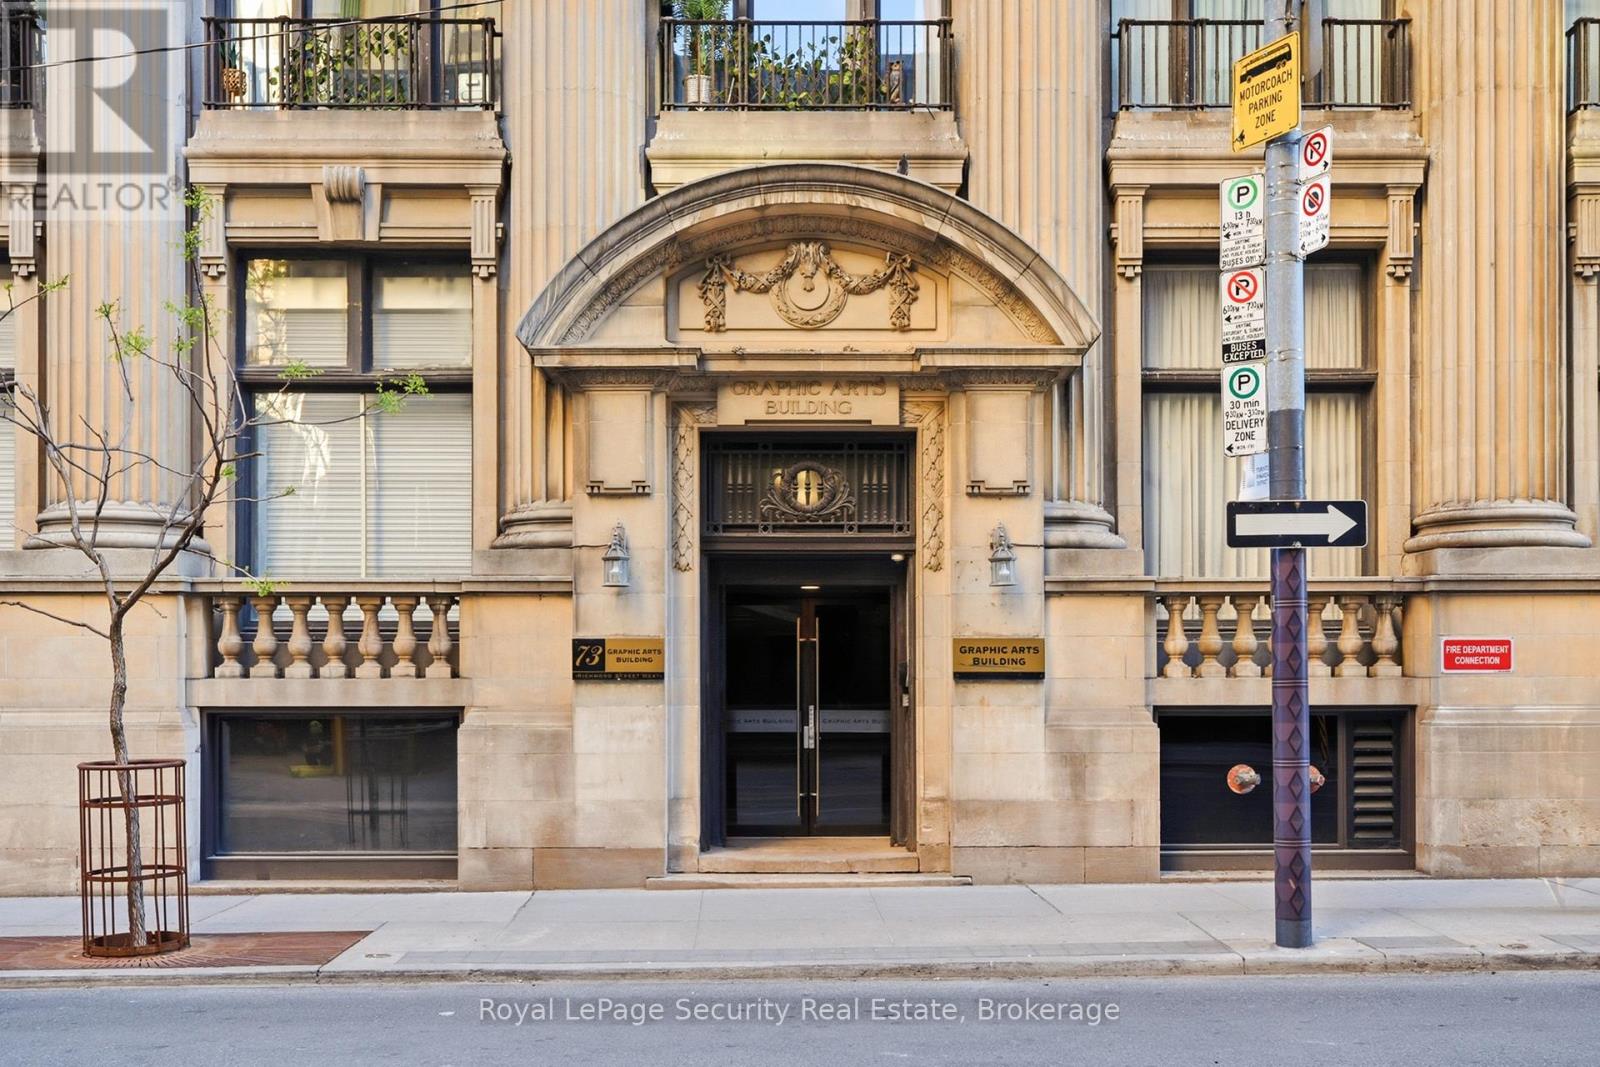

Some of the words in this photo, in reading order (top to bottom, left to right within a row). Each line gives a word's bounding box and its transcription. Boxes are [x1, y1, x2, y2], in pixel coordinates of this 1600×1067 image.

[1240, 68, 1293, 101] MOTORCOACH
[1248, 90, 1283, 114] PARKING
[1255, 109, 1276, 129] ZONE
[1237, 186, 1250, 203] P
[1222, 257, 1244, 269] BUSES
[1245, 255, 1262, 264] ONLY
[1230, 341, 1257, 352] BUSES
[1224, 349, 1264, 362] EXCEPTED
[730, 380, 822, 397] GRAPHIC
[829, 379, 887, 396] ARTS
[1238, 374, 1251, 391] P
[765, 400, 852, 416] BUILDING
[1229, 400, 1241, 410] 30
[1243, 399, 1260, 409] min
[1225, 418, 1264, 431] DELIVERY
[1235, 431, 1256, 442] ZONE
[575, 645, 603, 667] 73
[959, 646, 1008, 655] GRAPHIC
[1011, 646, 1040, 655] ARTS
[1445, 645, 1462, 654] FIRE
[1462, 645, 1509, 654] DEPARTMENT
[972, 657, 1026, 666] BUILDING
[1454, 656, 1500, 665] CONNECTION
